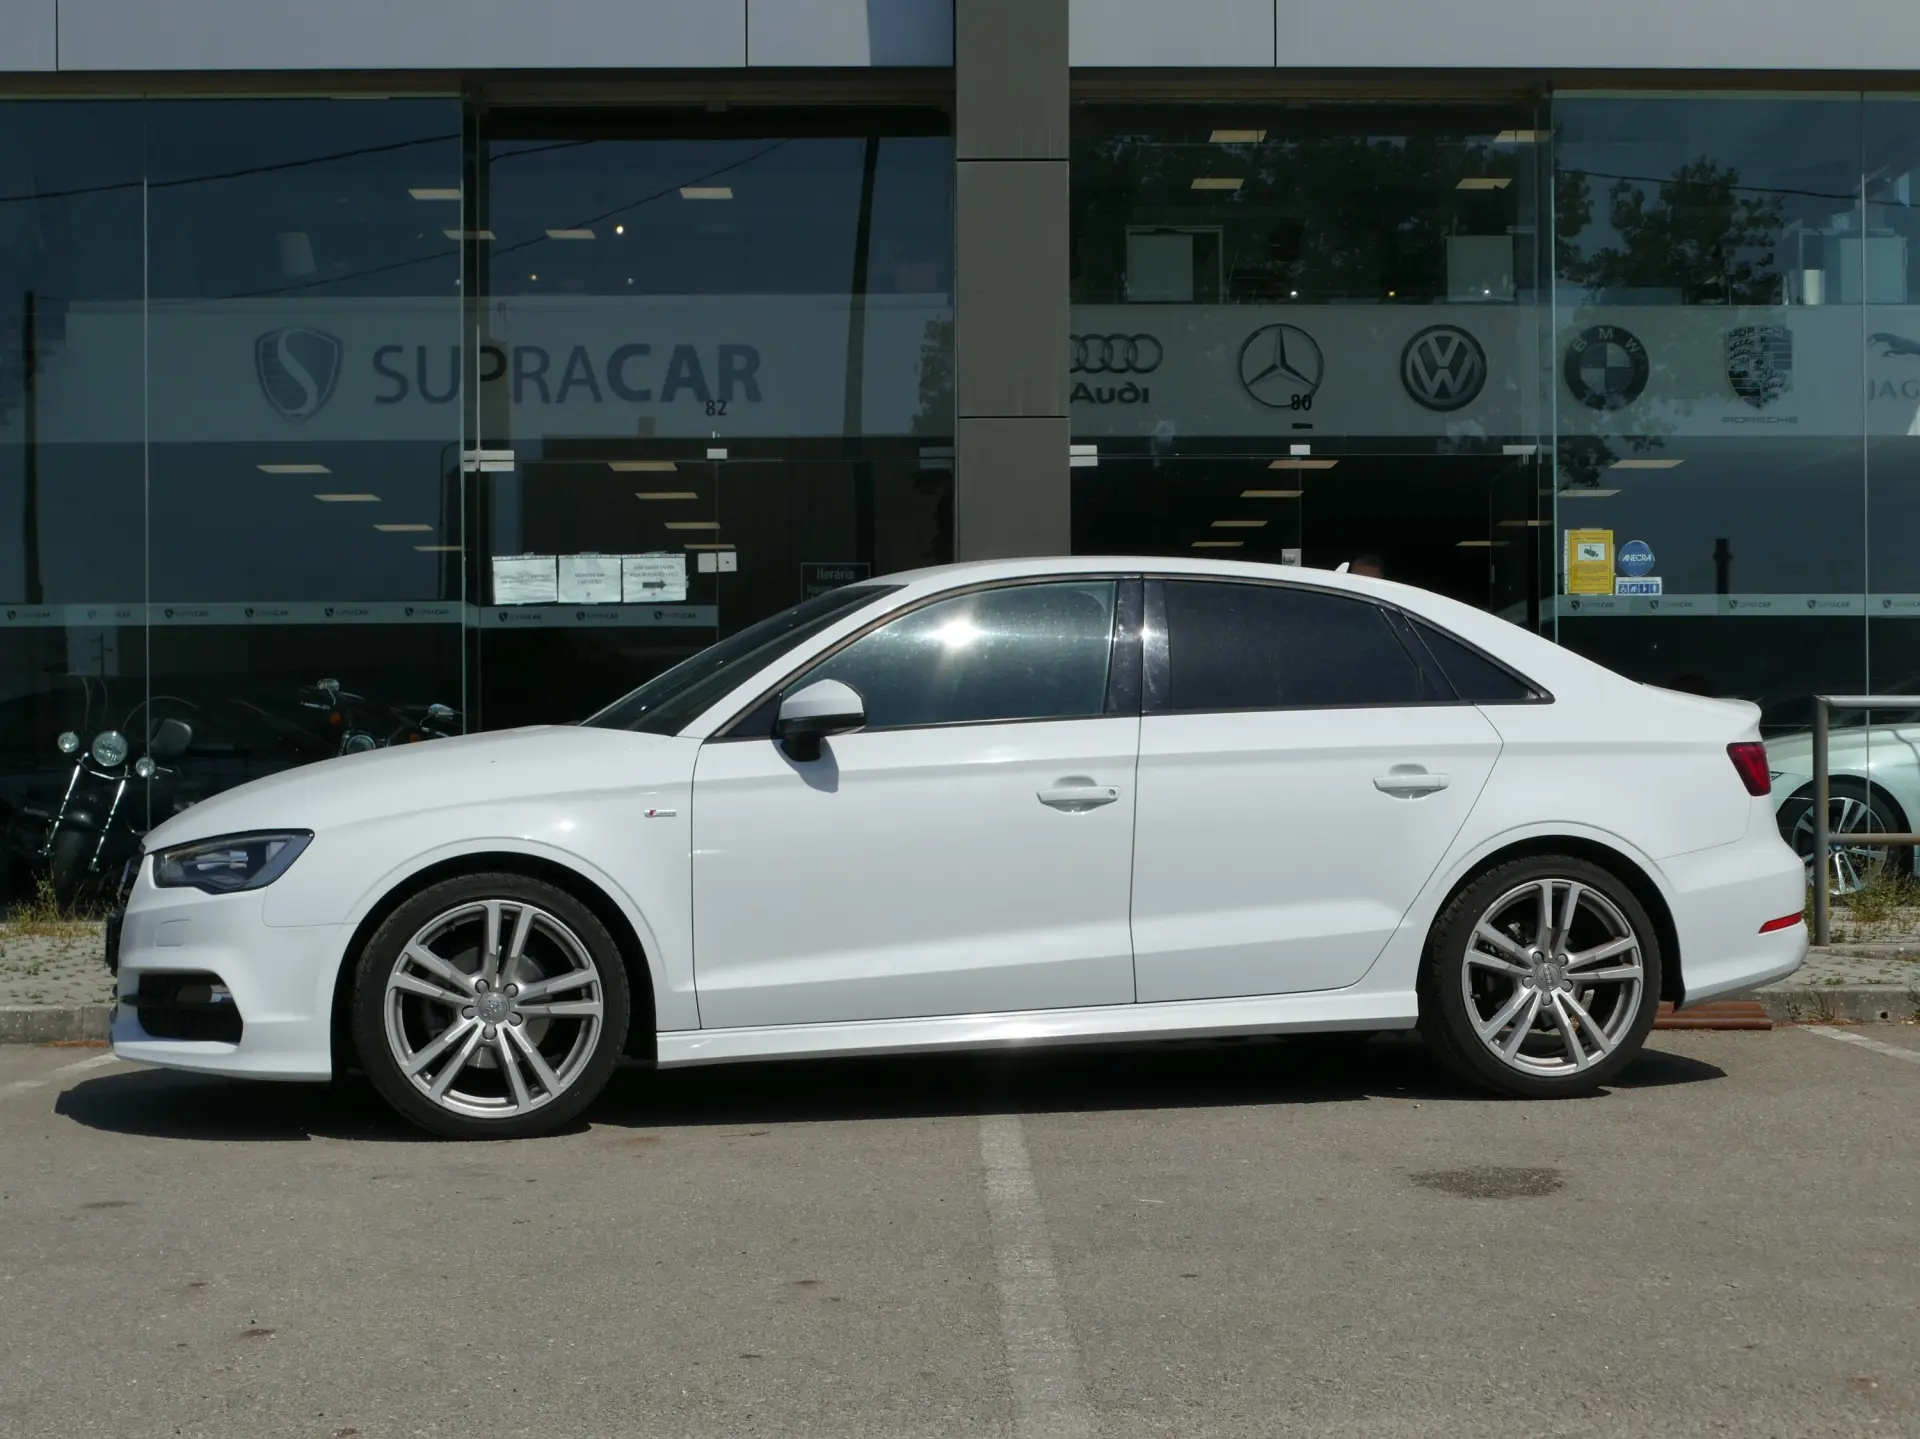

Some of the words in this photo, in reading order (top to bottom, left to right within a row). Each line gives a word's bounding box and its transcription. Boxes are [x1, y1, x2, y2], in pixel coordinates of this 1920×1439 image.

[1572, 327, 1641, 353] BMW
[371, 342, 764, 406] SUPRACAR
[1070, 381, 1150, 405] Audi
[1868, 378, 1920, 402] JAG
[704, 400, 728, 417] 82
[1290, 394, 1312, 411] 80
[1722, 416, 1799, 424] PORSCHE
[1621, 553, 1652, 562] ANECRA
